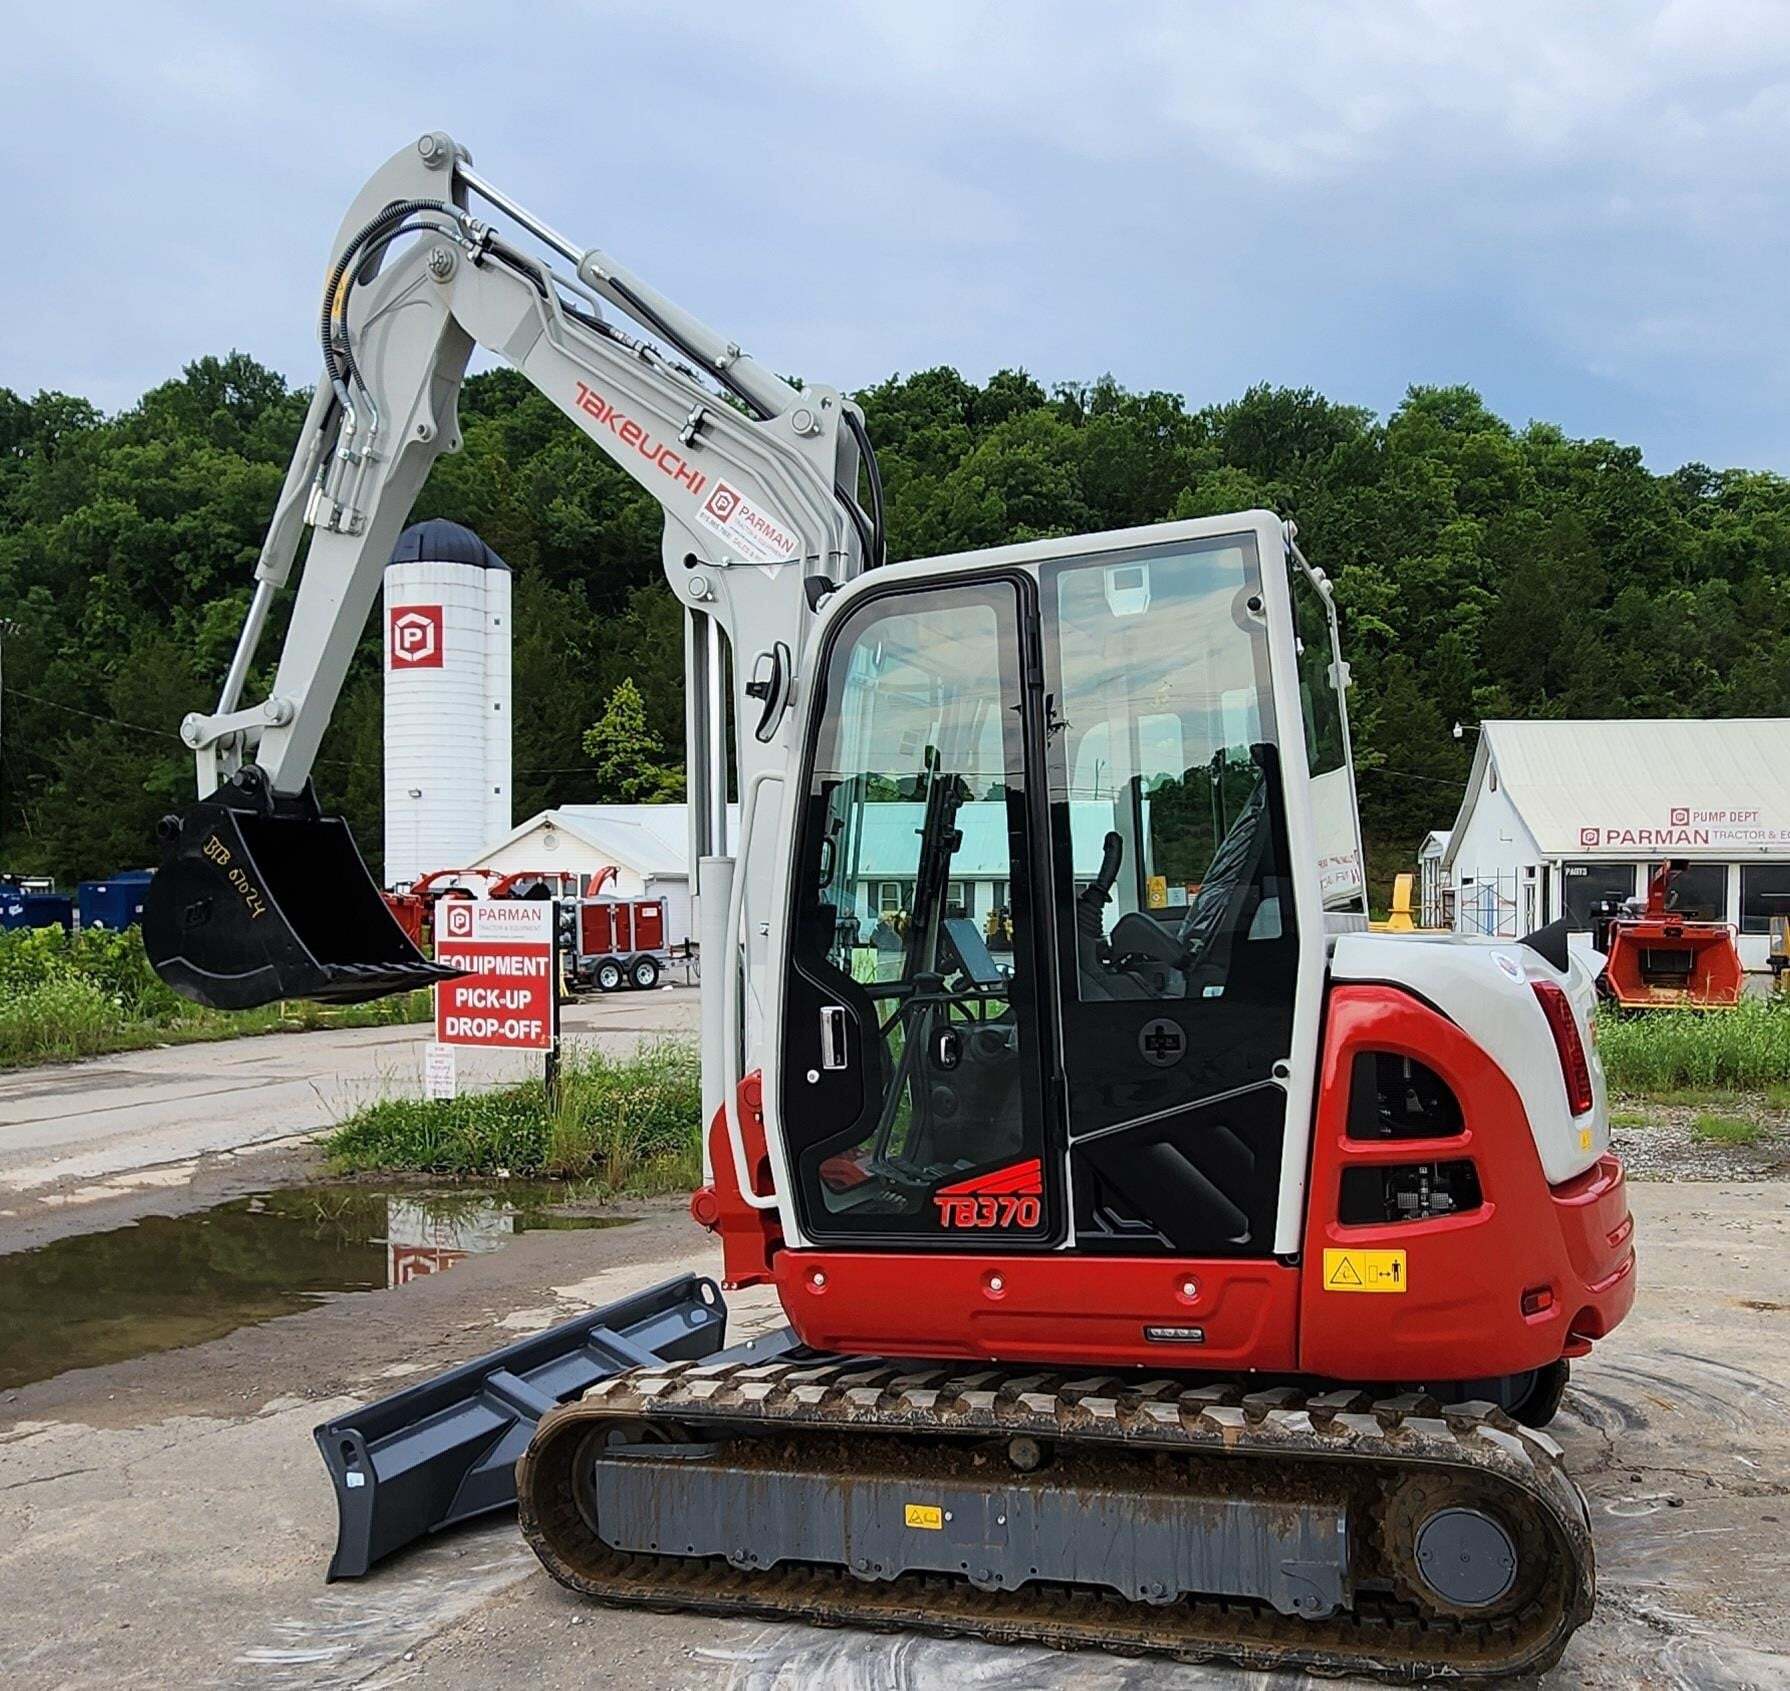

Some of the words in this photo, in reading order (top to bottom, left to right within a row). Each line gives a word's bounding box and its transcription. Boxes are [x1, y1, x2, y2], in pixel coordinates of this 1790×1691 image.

[739, 505, 794, 552] PARMAN
[403, 628, 423, 649] P
[1693, 811, 1727, 822] PUMP
[1729, 811, 1759, 822] DEPT
[1606, 829, 1709, 844] PARMAN
[1713, 831, 1766, 839] TRACTOR
[1768, 831, 1777, 840] &
[479, 908, 541, 921] PARMAN
[455, 987, 533, 1010] PICK-UP
[445, 1016, 543, 1040] DROP-OFF
[933, 1197, 1040, 1227] TB370
